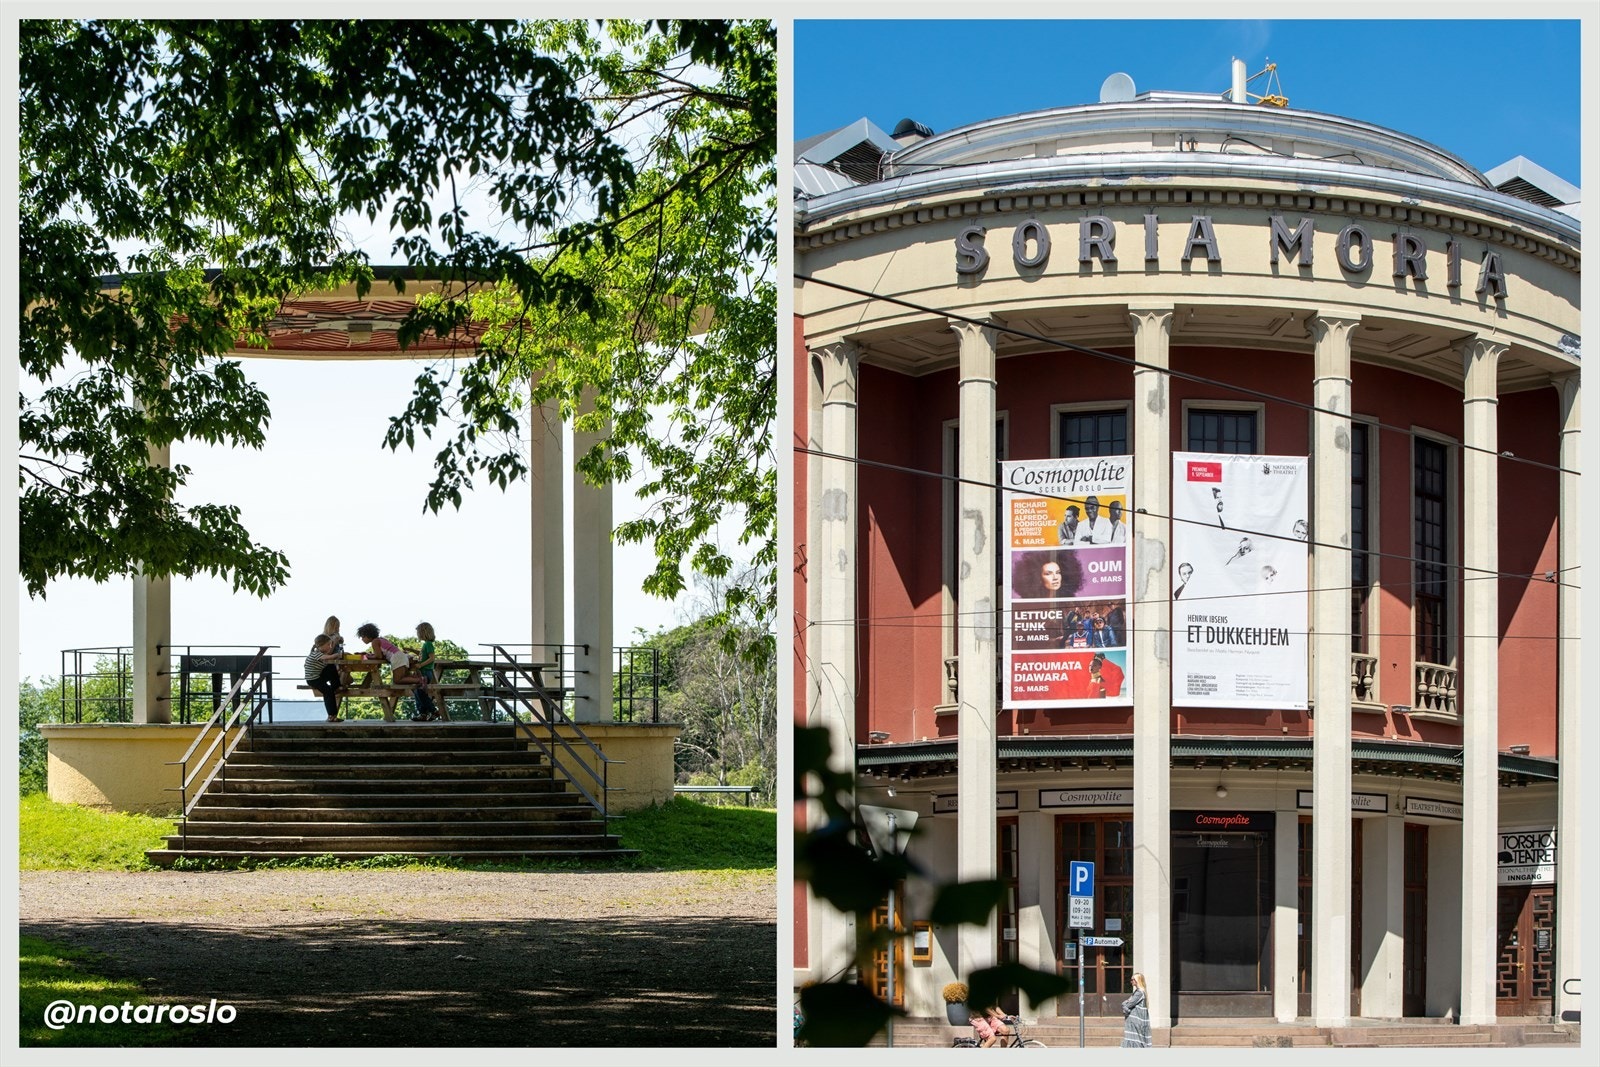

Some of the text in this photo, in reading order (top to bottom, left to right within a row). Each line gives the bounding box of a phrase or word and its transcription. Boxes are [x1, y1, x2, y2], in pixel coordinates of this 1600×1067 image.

[955, 213, 1508, 299] SORIA MORIA
[1010, 460, 1125, 492] Cosmopolite
[1088, 560, 1122, 573] OUM
[1014, 611, 1063, 620] LETTUCE
[1187, 614, 1228, 624] HENRIK IBSENS
[1014, 622, 1046, 631] FUNK
[1187, 625, 1289, 646] ET DUKKEHJEM
[1014, 661, 1082, 671] FATOUMATA
[1014, 672, 1068, 682] DIAWARA
[1059, 791, 1122, 804] Cosmopolite
[1410, 802, 1434, 812] TEATRET
[1196, 814, 1250, 828] Cosmopolite
[1512, 848, 1557, 864] TEATRET
[1076, 866, 1089, 892] P
[1074, 898, 1089, 906] 09-20
